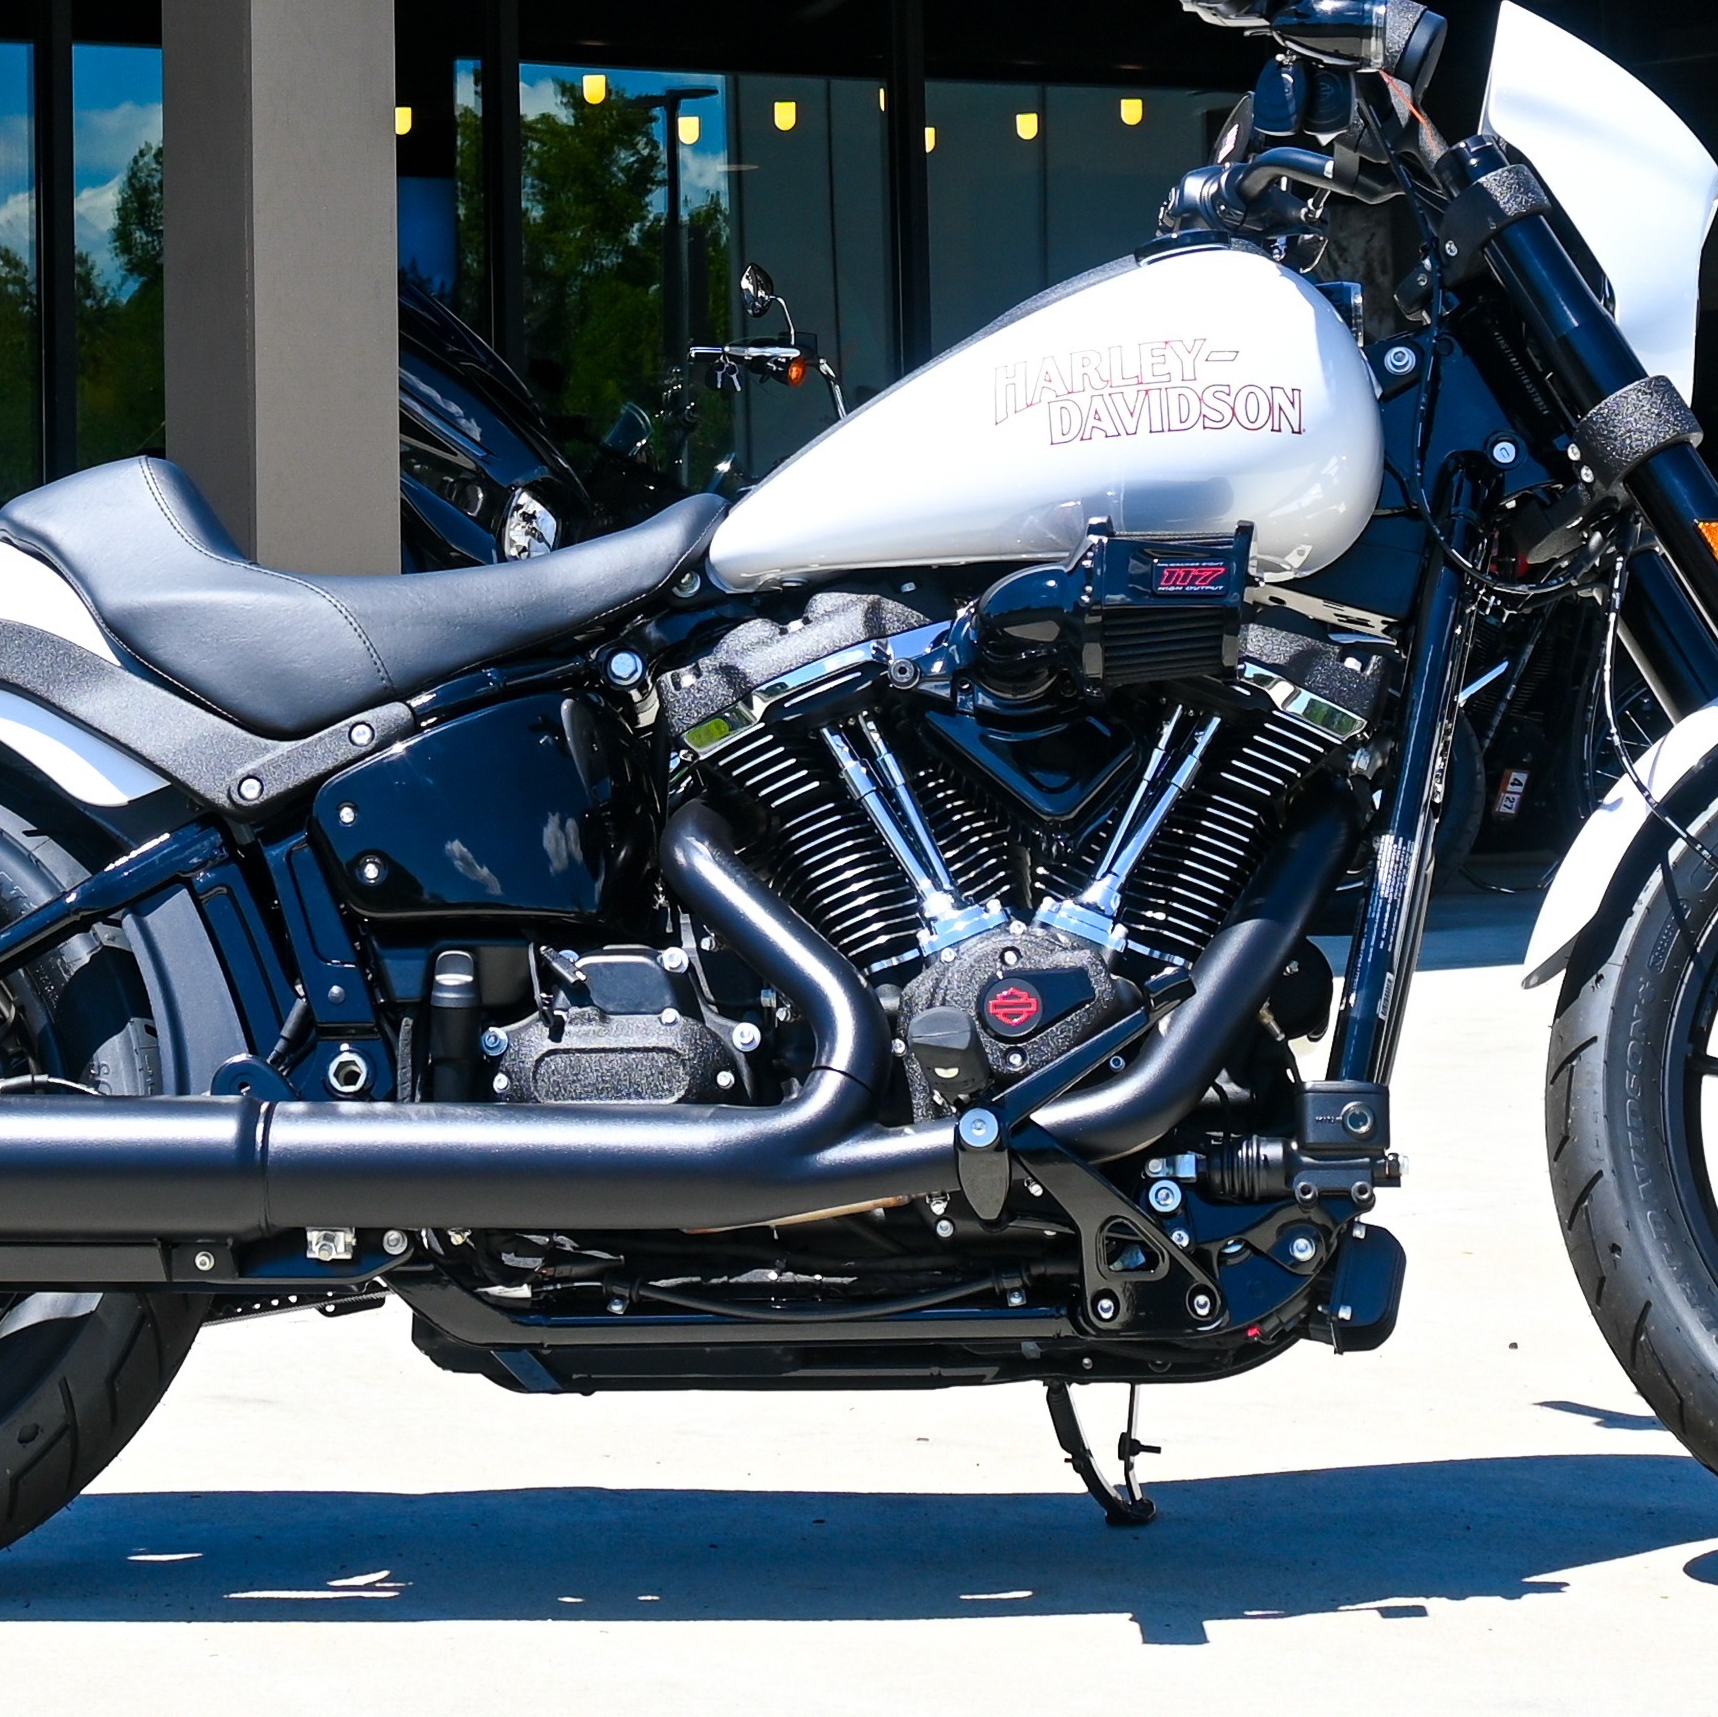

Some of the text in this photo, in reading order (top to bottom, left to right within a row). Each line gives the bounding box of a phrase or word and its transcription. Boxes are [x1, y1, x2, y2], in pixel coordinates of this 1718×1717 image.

[994, 338, 1239, 426] HARLEY-
[1049, 383, 1303, 445] DAVIDSON
[1160, 567, 1227, 586] 117
[1510, 777, 1524, 787] 4
[1503, 795, 1516, 810] 27
